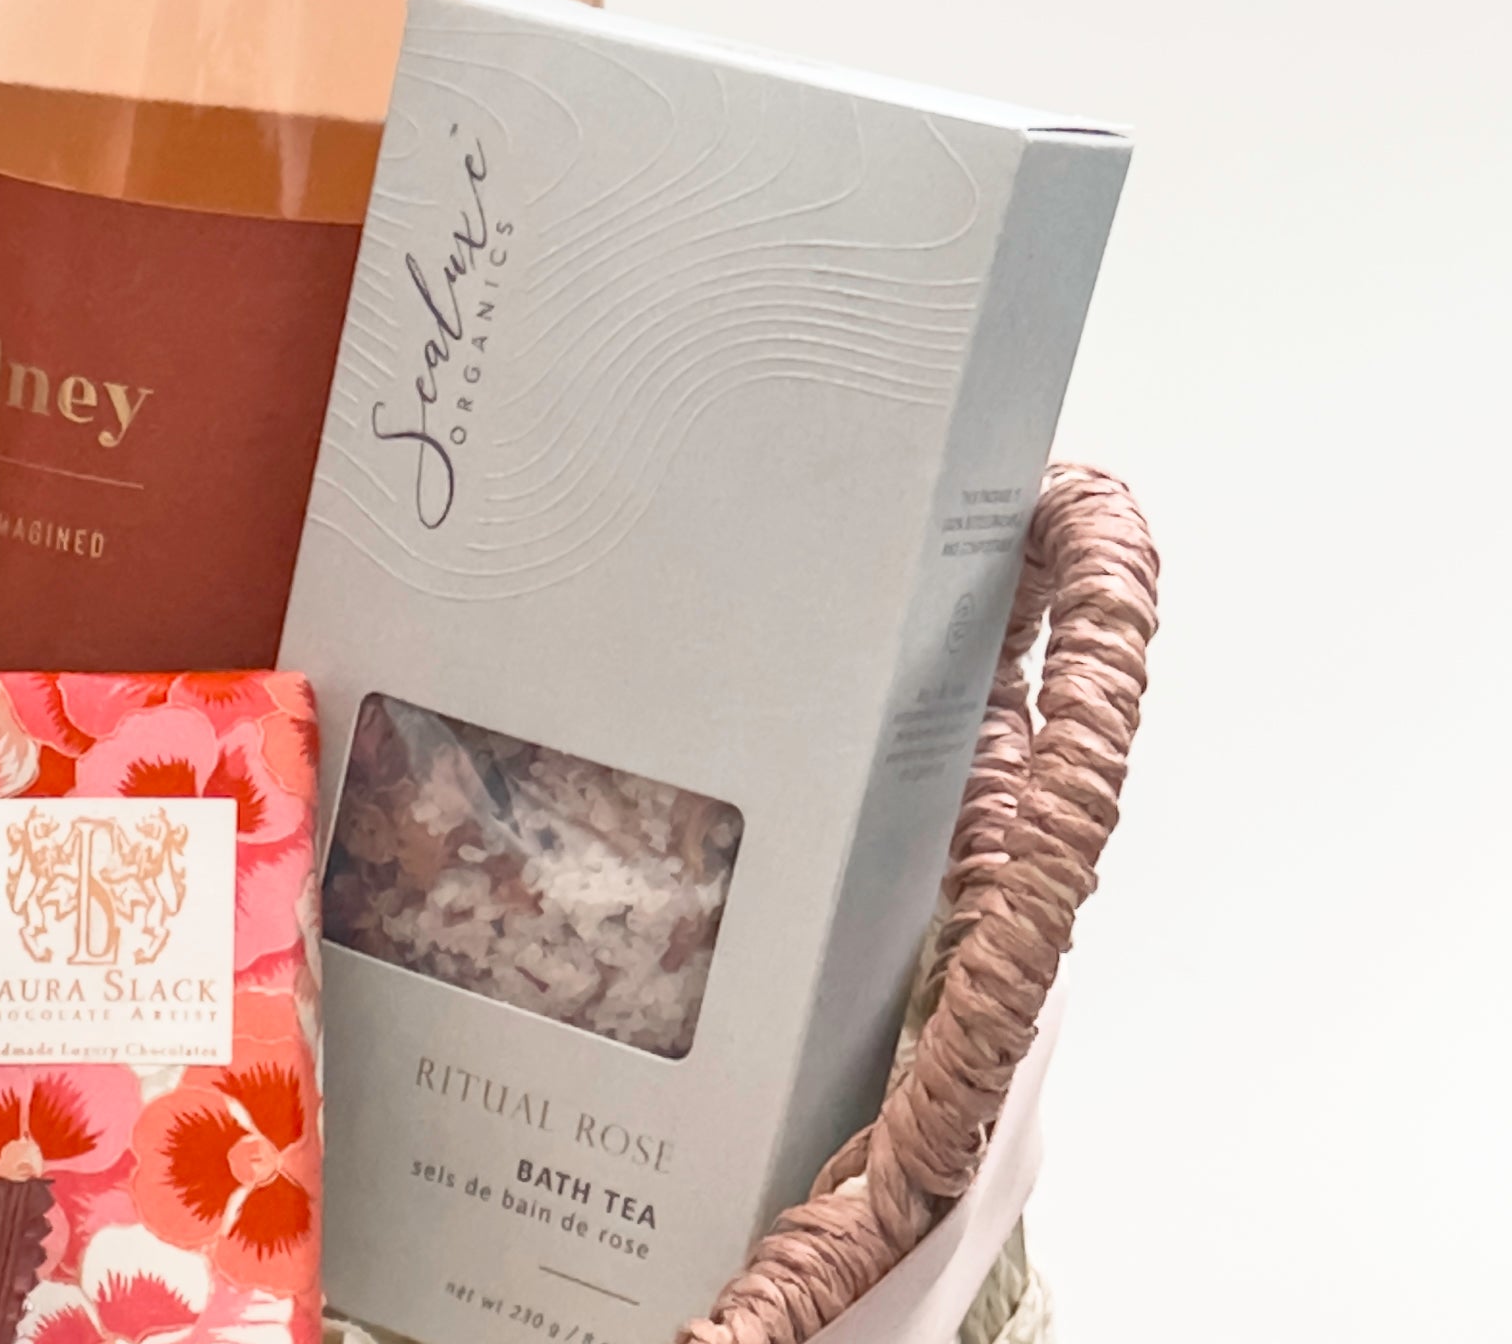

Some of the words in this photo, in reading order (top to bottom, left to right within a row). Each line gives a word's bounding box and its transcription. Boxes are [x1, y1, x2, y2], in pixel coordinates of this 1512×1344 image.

[449, 220, 514, 446] ORGANICS
[103, 969, 218, 1003] SLACK
[61, 1043, 118, 1058] Luxury
[125, 1042, 218, 1058] Chocolates
[415, 1056, 554, 1132] RITUAL
[574, 1112, 675, 1175] ROSE
[410, 1158, 456, 1189] sels
[464, 1174, 492, 1202] de
[501, 1189, 552, 1224] bain
[560, 1210, 589, 1237] de
[598, 1226, 651, 1260] rose
[517, 1158, 591, 1204] BATH
[603, 1189, 657, 1229] TEA
[445, 1281, 476, 1304] net
[481, 1295, 504, 1314] wt
[508, 1304, 544, 1329] 230
